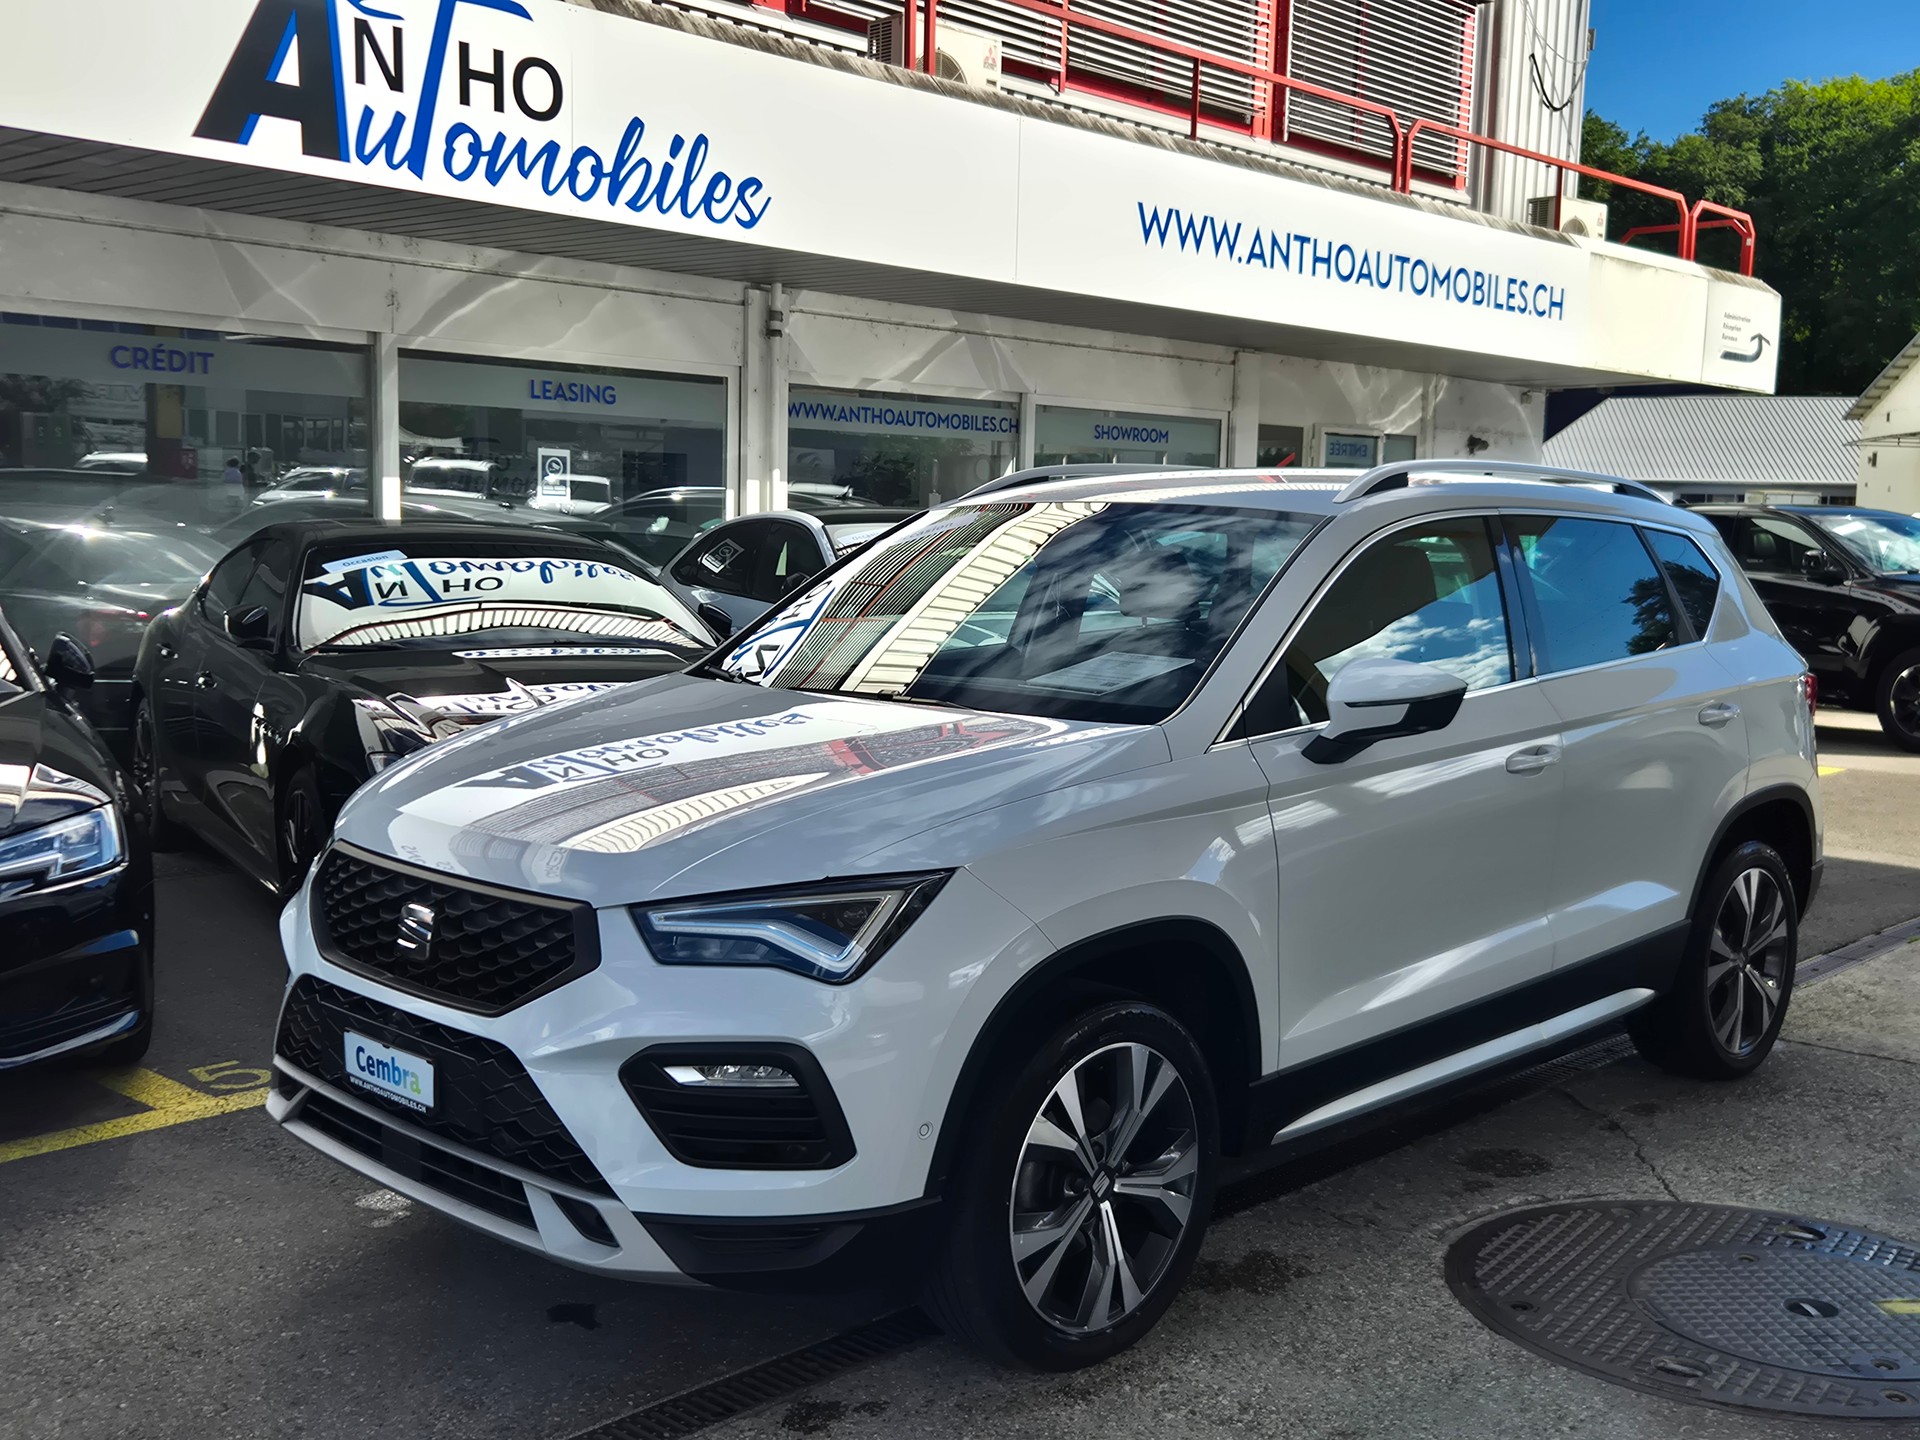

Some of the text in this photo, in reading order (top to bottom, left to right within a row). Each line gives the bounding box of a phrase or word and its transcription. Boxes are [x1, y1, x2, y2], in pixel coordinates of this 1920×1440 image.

[1137, 202, 1565, 321] WWW.ANTHOAUTOMOBILES.CH
[110, 344, 214, 374] CRÉDIT
[529, 379, 617, 406] LEASING
[788, 402, 1019, 433] WWW.ANTHOAUTOMOBILES.CH
[1094, 424, 1169, 444] SHOWROOM
[342, 554, 389, 567] Occasion
[355, 1045, 421, 1095] Cembra
